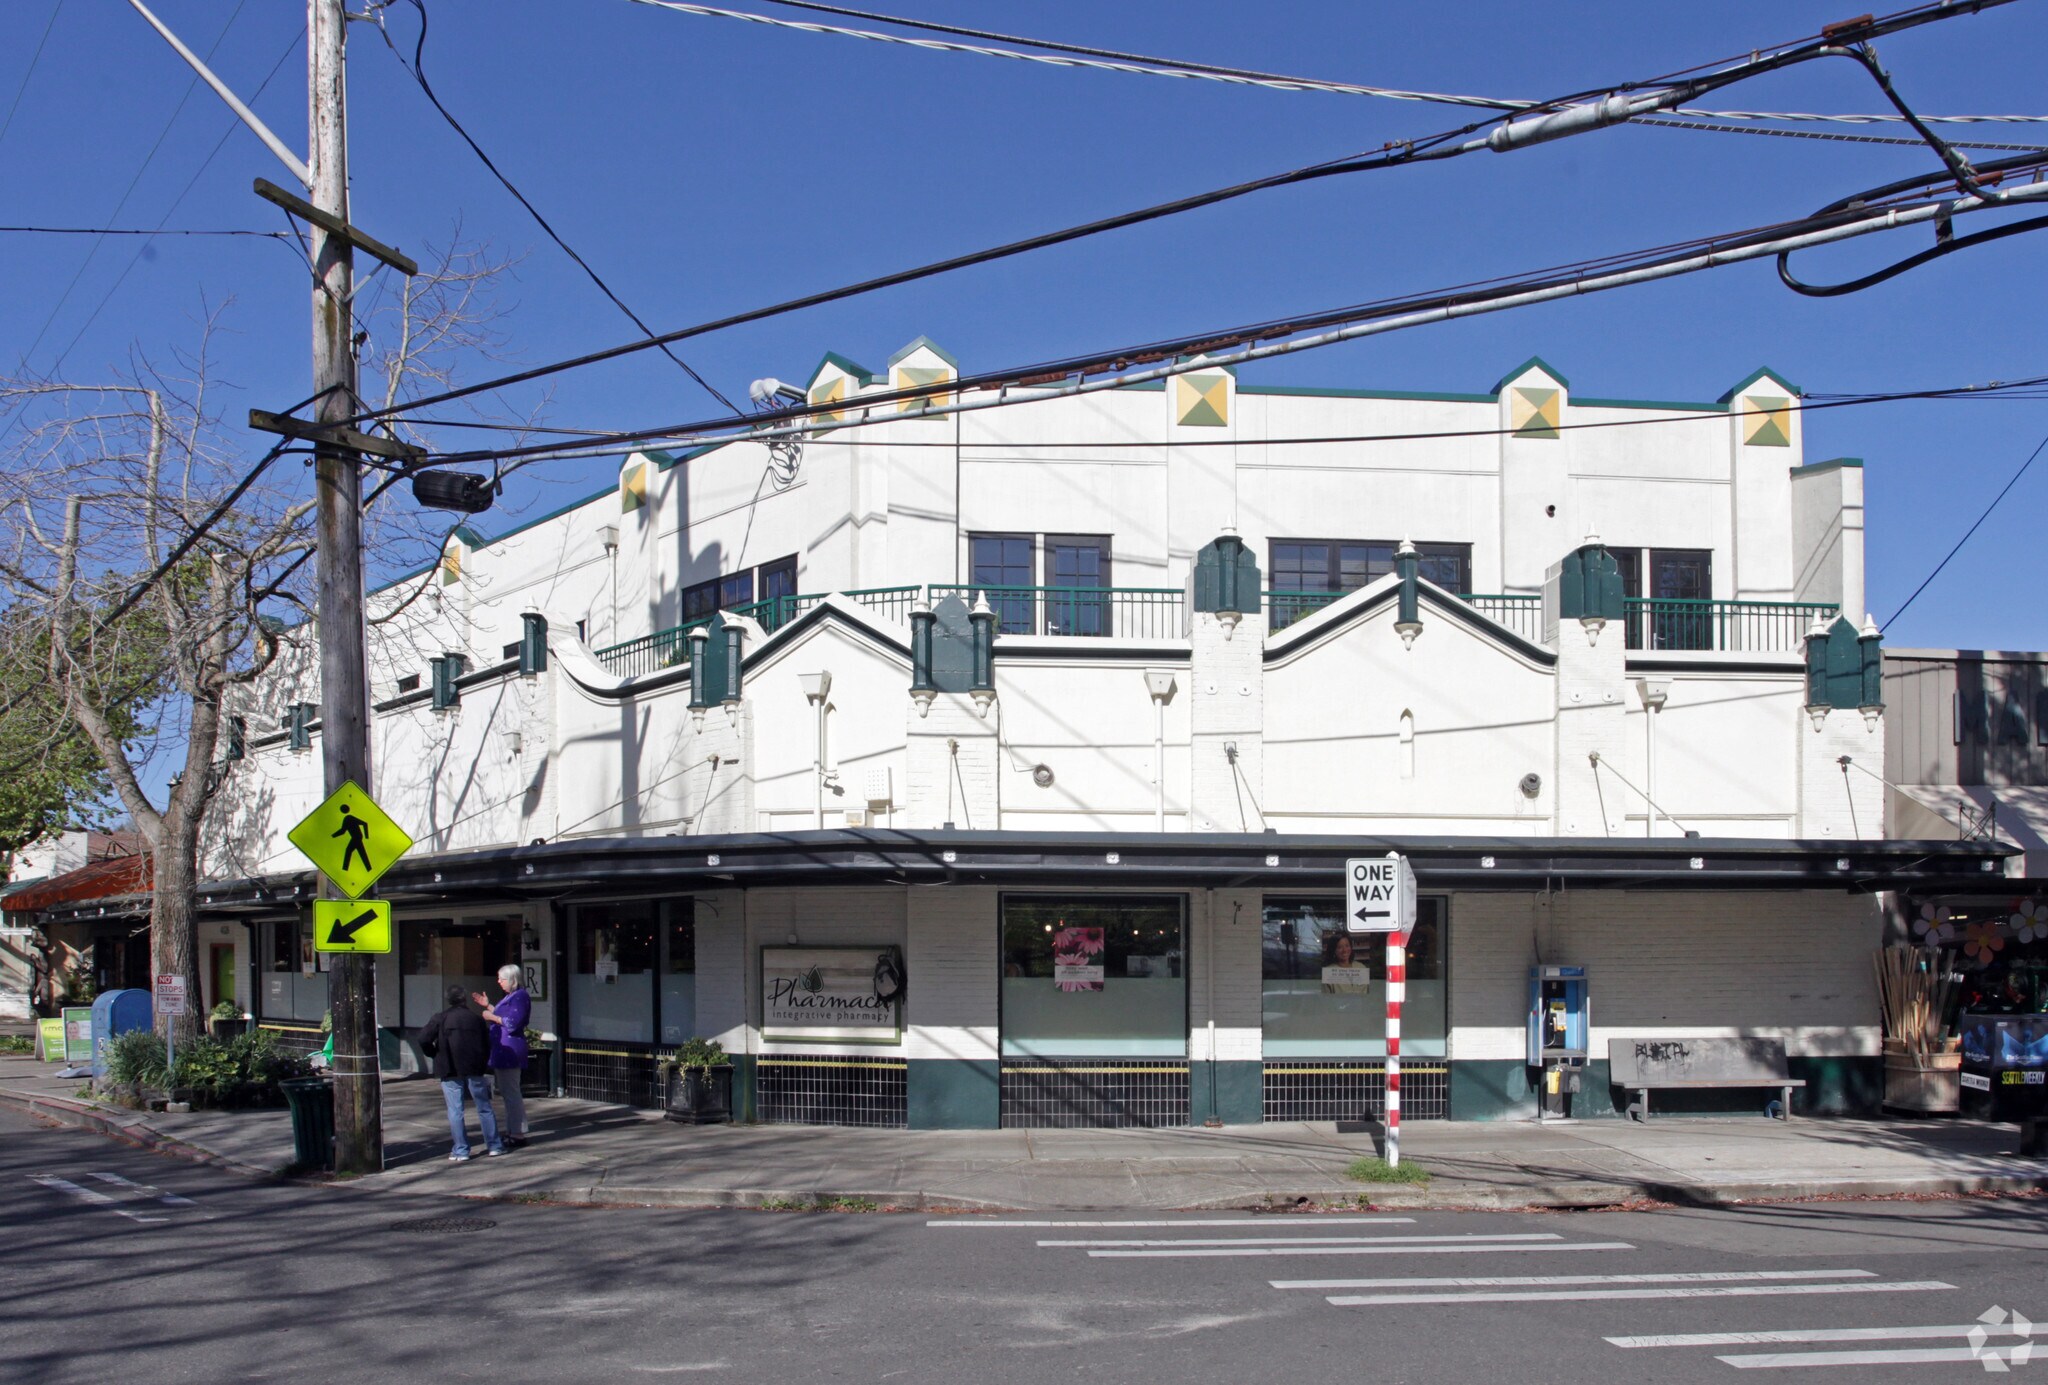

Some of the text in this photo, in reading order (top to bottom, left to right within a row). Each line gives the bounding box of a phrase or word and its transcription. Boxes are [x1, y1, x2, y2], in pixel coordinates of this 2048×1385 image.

[1354, 865, 1393, 881] ONE
[1354, 885, 1394, 901] WAY
[772, 1011, 832, 1021] integrative
